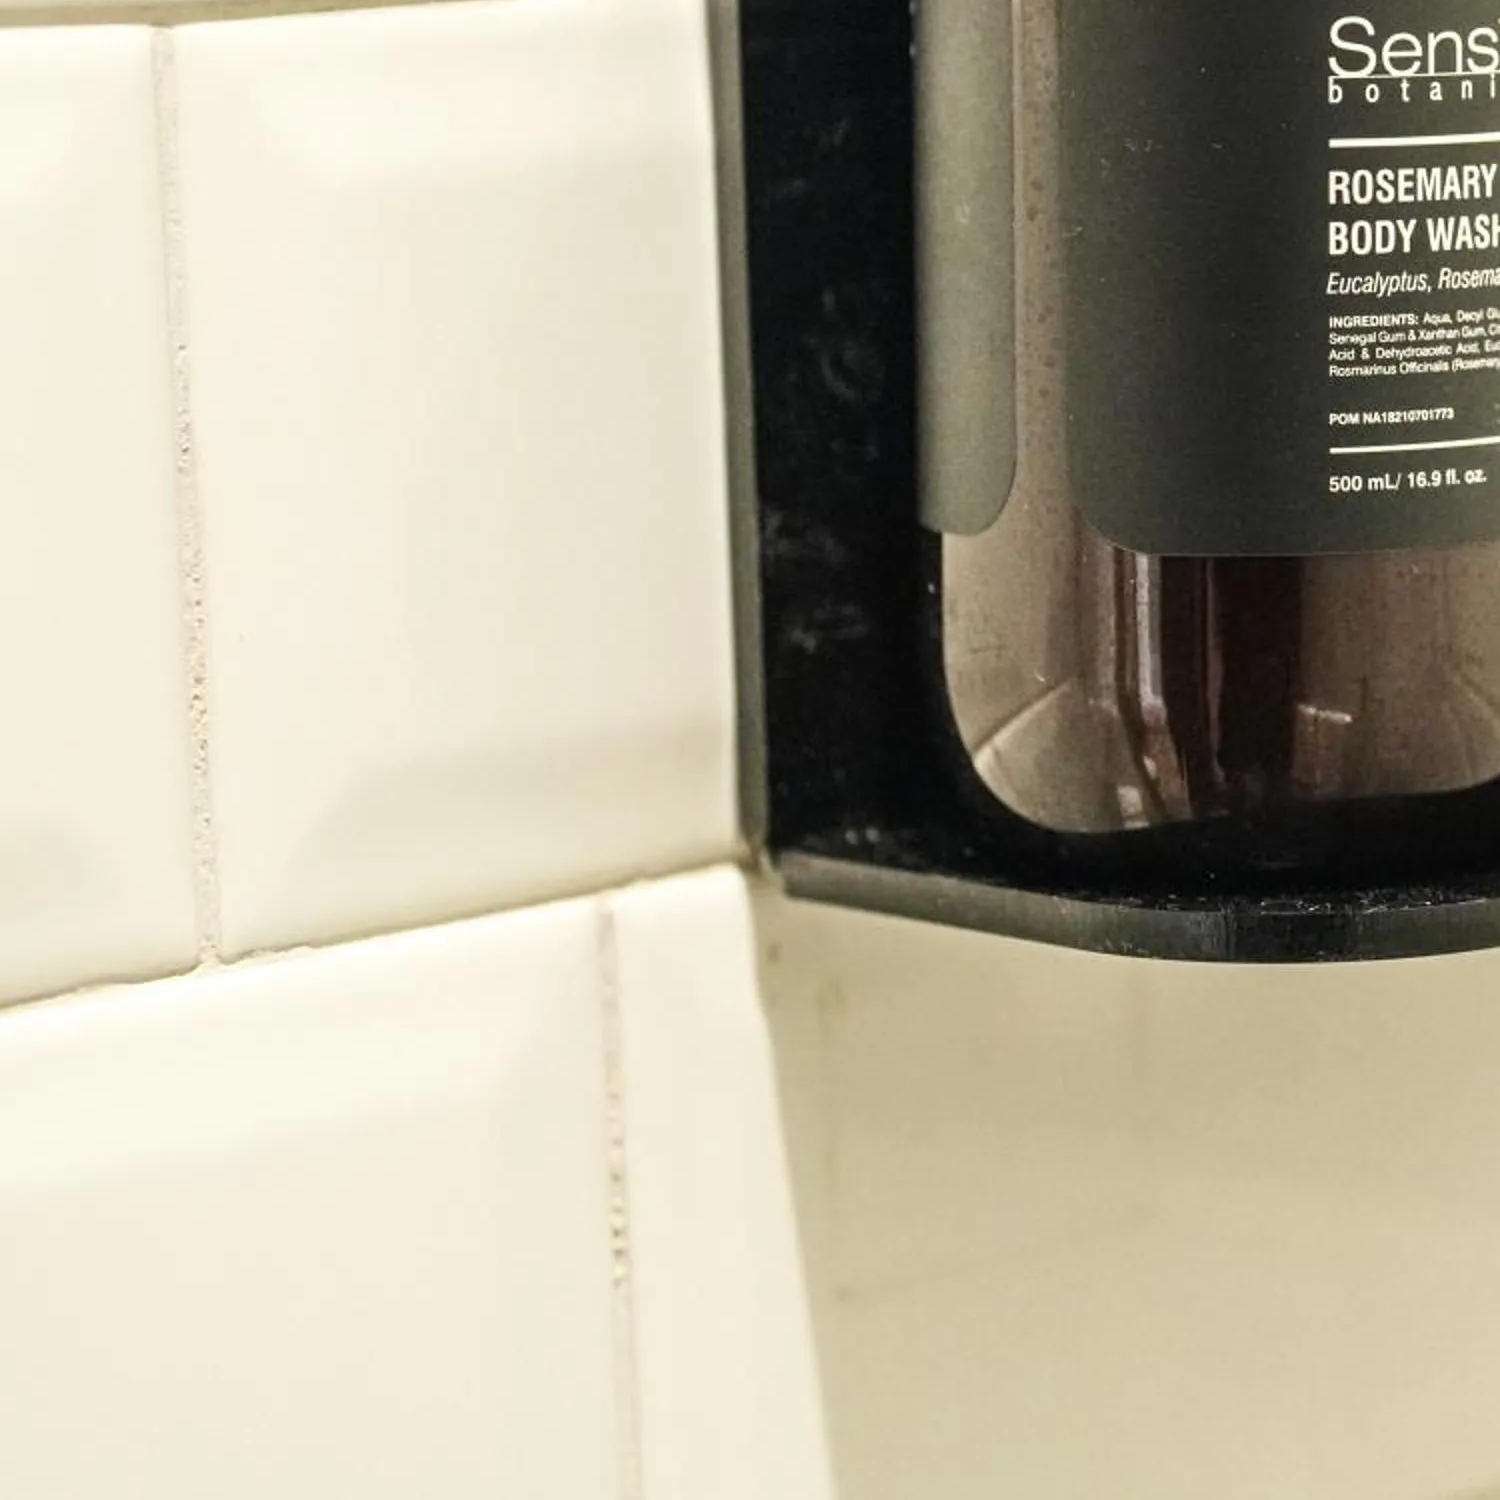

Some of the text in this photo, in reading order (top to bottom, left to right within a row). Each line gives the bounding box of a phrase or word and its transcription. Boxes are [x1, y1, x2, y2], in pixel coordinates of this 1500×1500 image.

[1328, 163, 1498, 205] ROSEMARY
[1328, 218, 1417, 256] BODY
[1326, 270, 1432, 297] Eucalyptus,
[1328, 313, 1419, 329] INGREDIENTS:
[1328, 331, 1377, 347] Senegal
[1378, 330, 1407, 343] Gum
[1407, 328, 1417, 341] &
[1328, 347, 1355, 361] Acid
[1360, 347, 1371, 360] &
[1328, 363, 1397, 378] Rosmarinus
[1328, 412, 1360, 425] POM
[1328, 467, 1488, 493] 500 mL/ 16.9 fl. oz.
